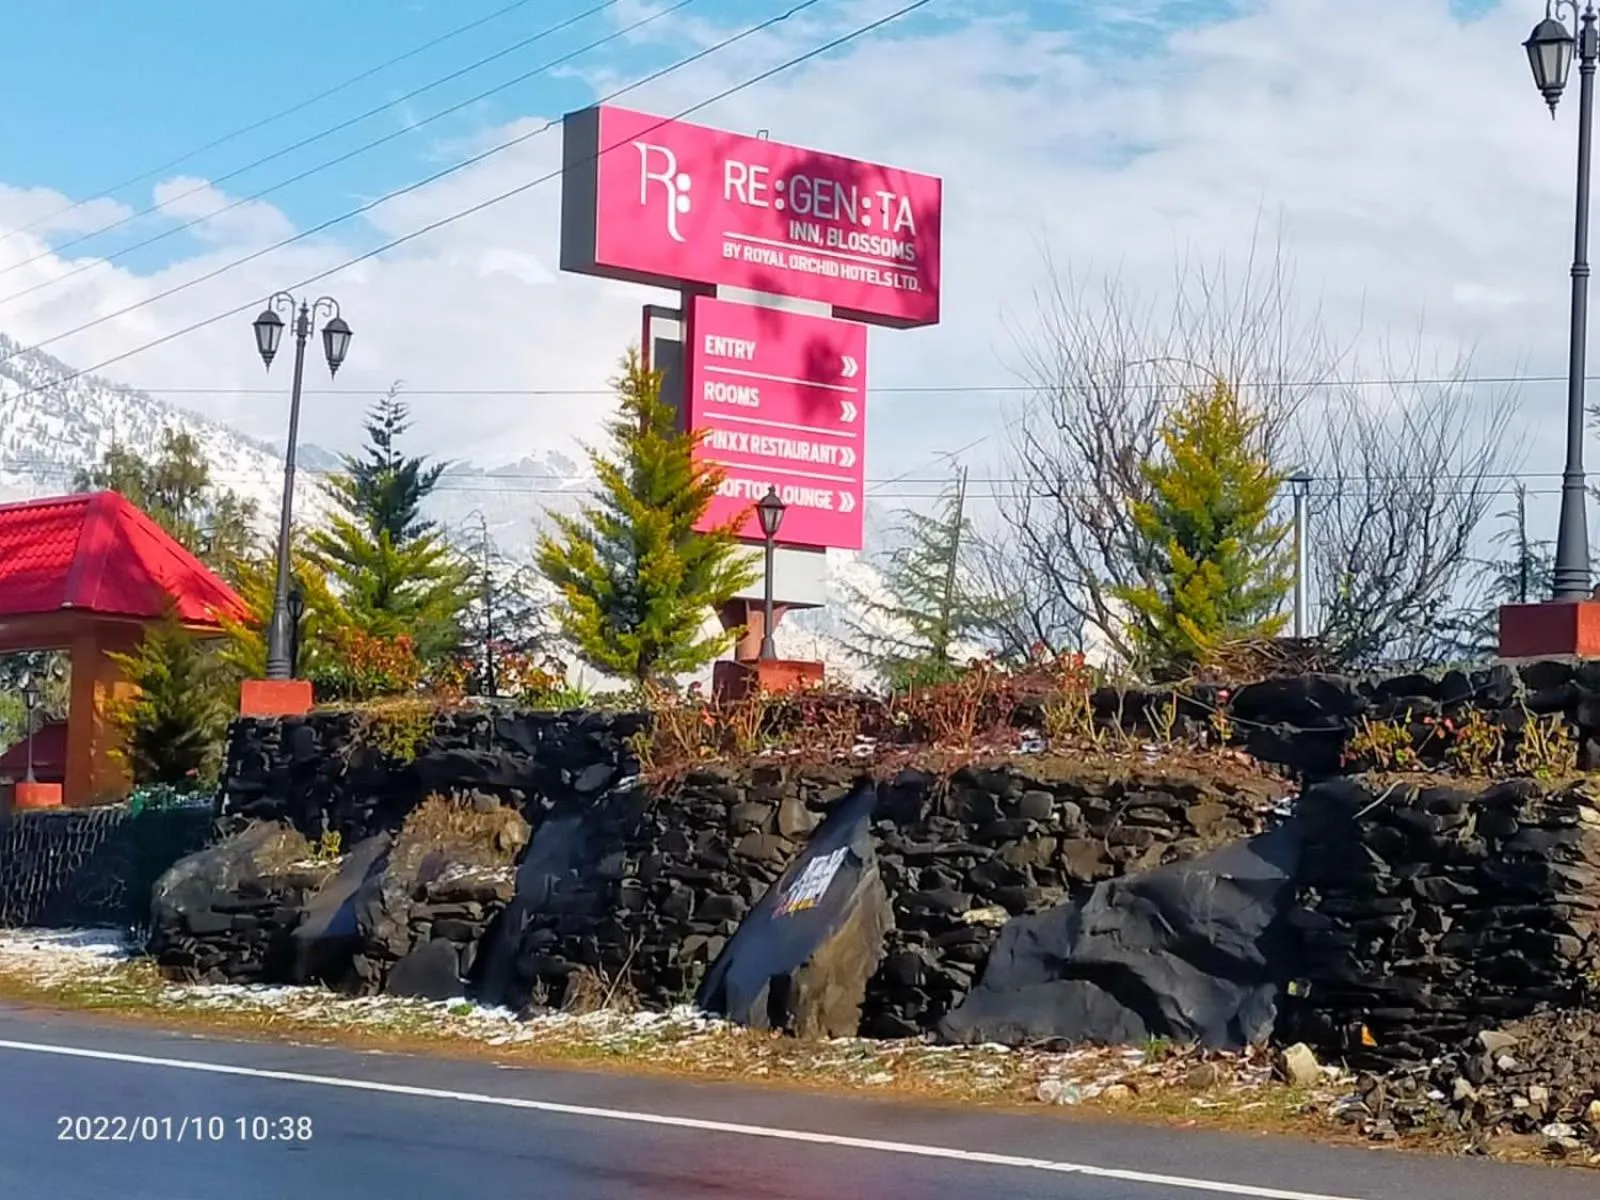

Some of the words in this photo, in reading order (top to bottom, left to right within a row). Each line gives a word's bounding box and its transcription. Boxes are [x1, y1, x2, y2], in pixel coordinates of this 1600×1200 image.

[789, 220, 824, 247] INN,
[826, 230, 916, 261] BLOSSOMS
[723, 243, 741, 260] BY
[743, 246, 787, 269] ROYAL
[789, 254, 839, 278] ORCHID
[840, 259, 893, 287] HOTELS
[894, 274, 922, 293] LTD.
[704, 334, 756, 361] ENTRY
[704, 381, 760, 408] ROOMS
[750, 434, 838, 465] RESTAURANT
